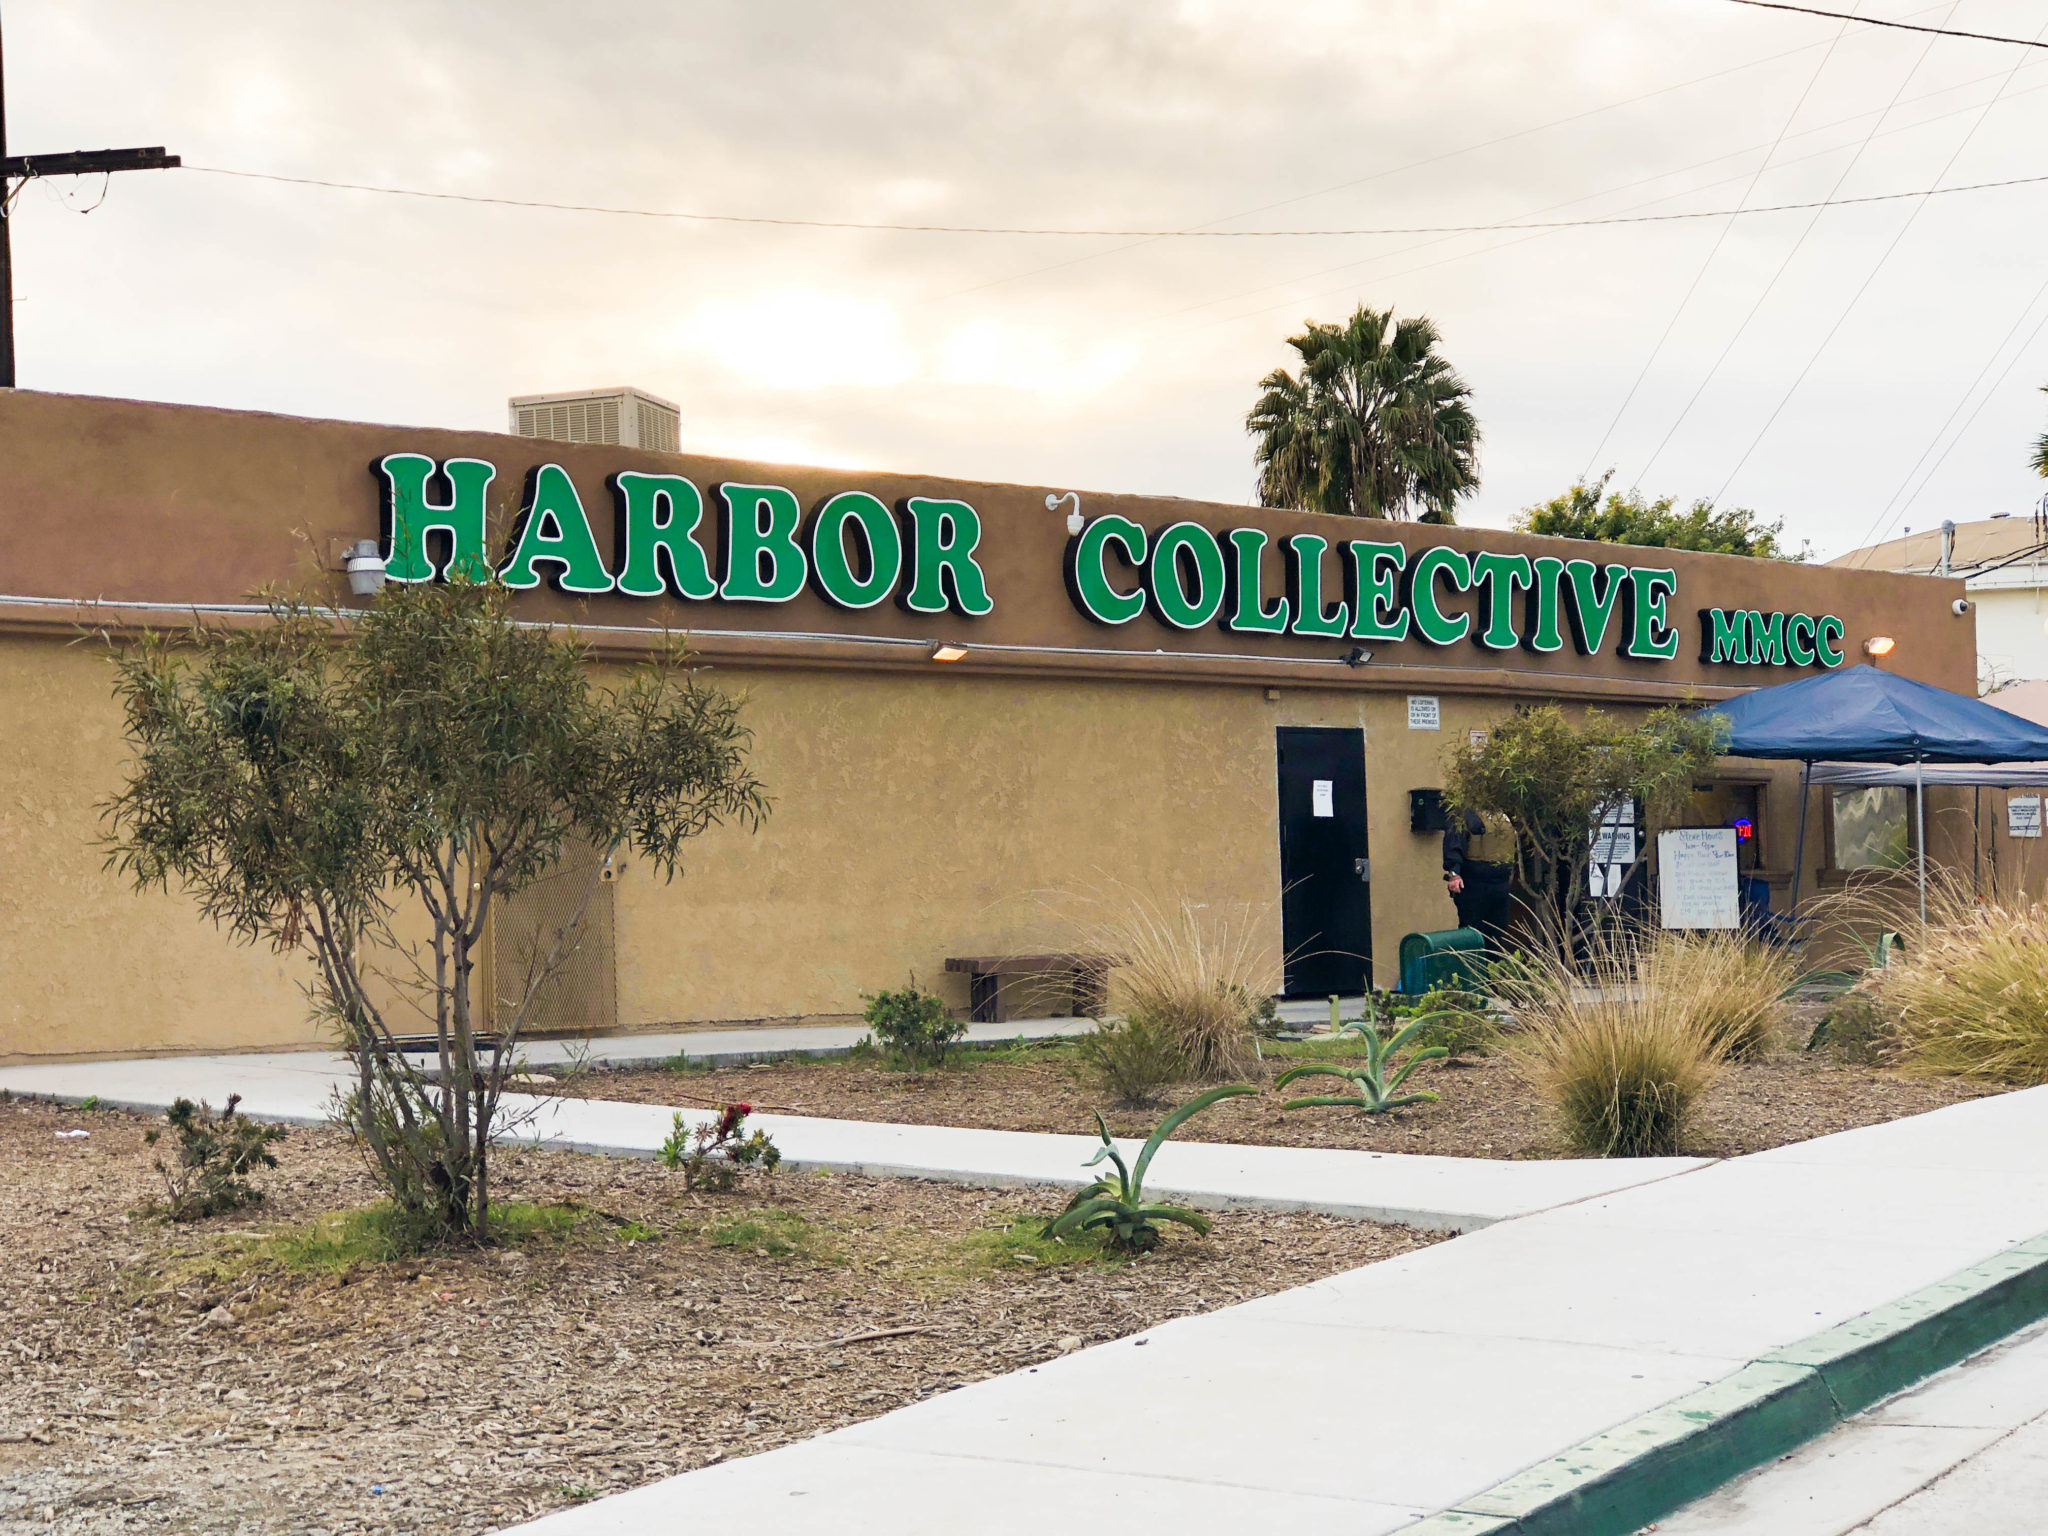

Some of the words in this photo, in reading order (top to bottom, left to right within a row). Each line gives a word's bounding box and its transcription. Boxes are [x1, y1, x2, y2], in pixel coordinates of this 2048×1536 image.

[380, 452, 994, 616] HARBOR
[1074, 513, 1679, 660] COLLECTIVE
[1711, 607, 1846, 668] MMCC
[1602, 832, 1631, 840] WANING
